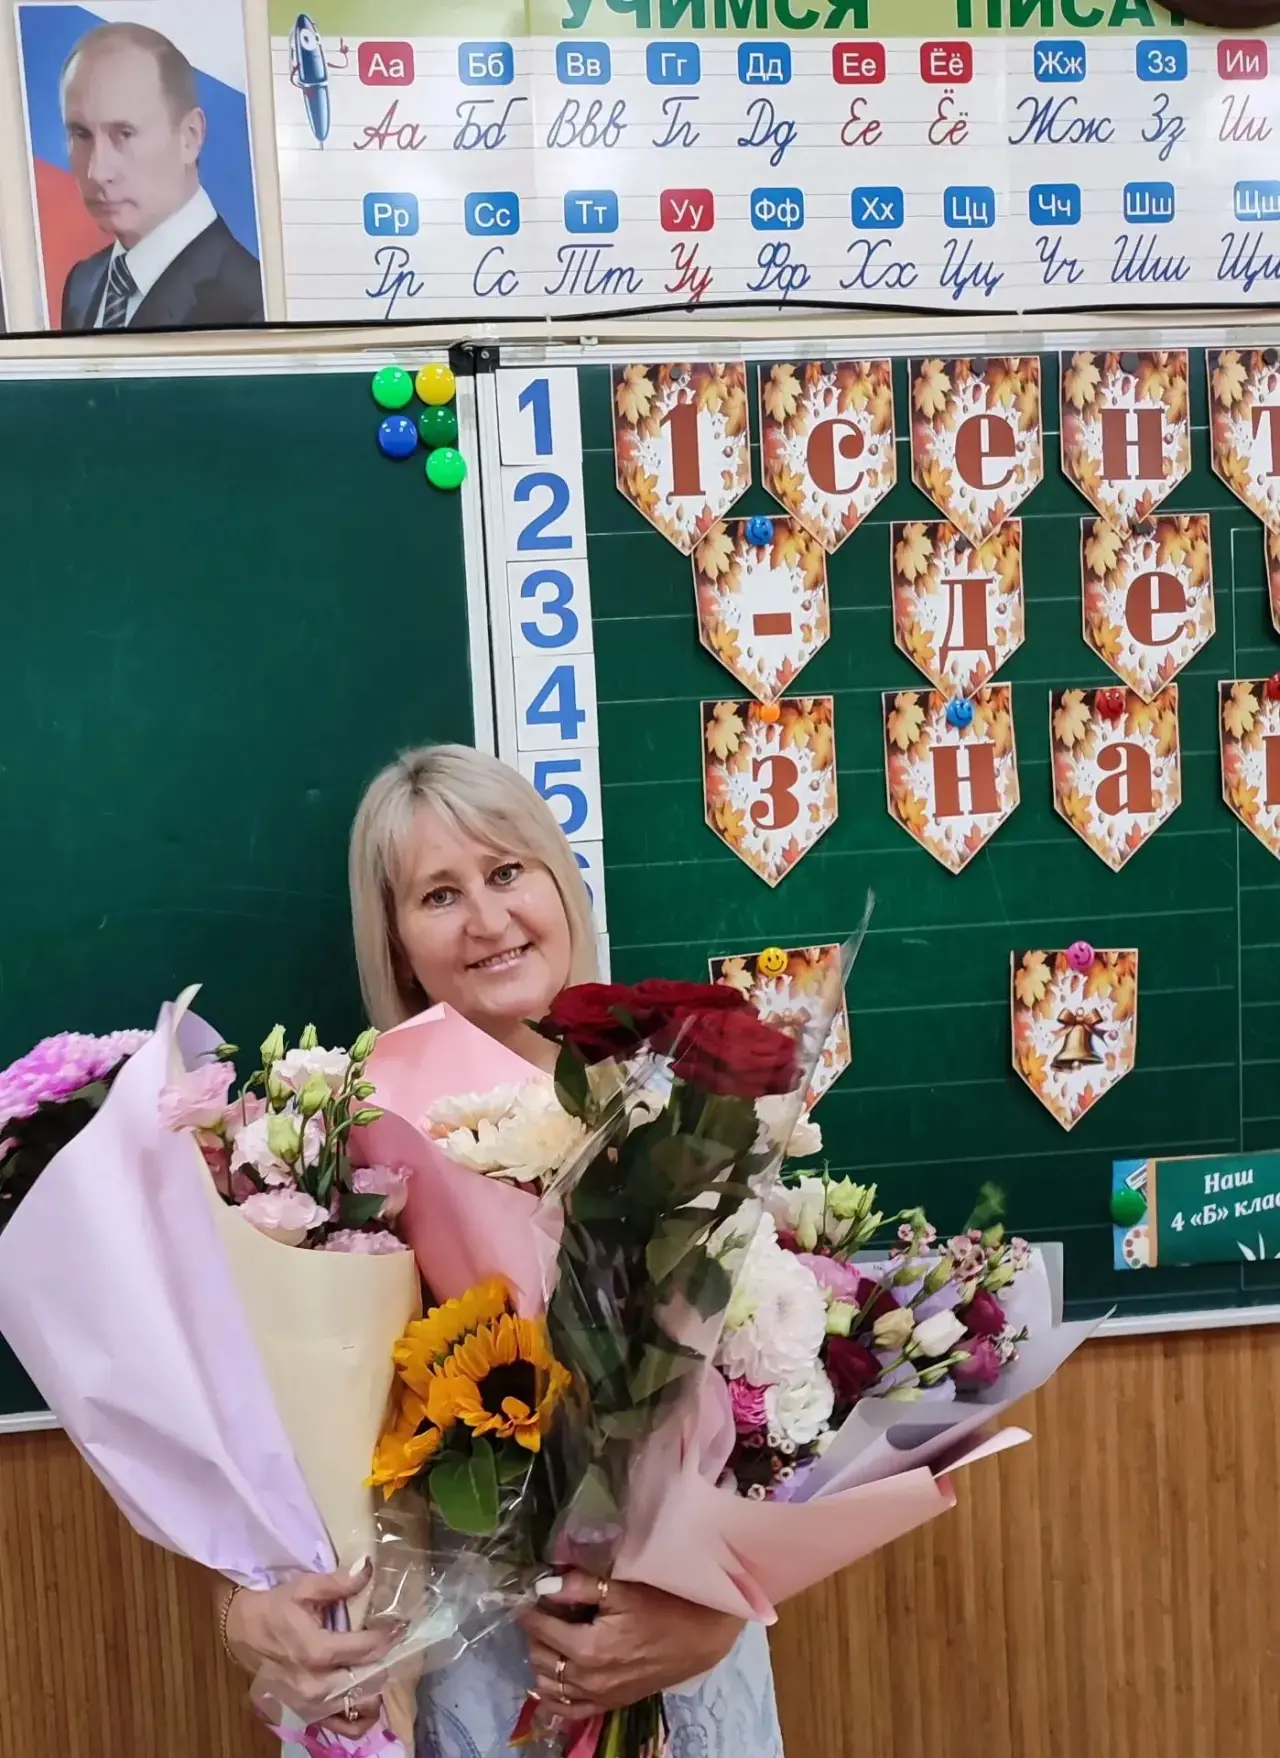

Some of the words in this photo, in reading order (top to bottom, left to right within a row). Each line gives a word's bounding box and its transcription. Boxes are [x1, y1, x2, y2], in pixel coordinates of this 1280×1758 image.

[561, 0, 869, 29] УЧИМСЯ
[367, 55, 405, 78] Аа
[468, 54, 504, 78] Бб
[567, 53, 601, 77] Вв
[660, 53, 688, 76] Гг
[746, 53, 784, 80] Дд
[843, 54, 877, 77] Ее
[930, 49, 964, 77] Ёё
[1037, 51, 1083, 75] Жж
[1148, 52, 1177, 75] Зз
[1226, 51, 1260, 73] Ии
[353, 99, 427, 151] Аа
[453, 96, 528, 151] Бб
[652, 96, 700, 148] Гг
[737, 98, 798, 168] Дд
[841, 97, 882, 147] Ее
[928, 89, 969, 146] Ёё
[1008, 96, 1115, 145] Жж
[1141, 93, 1186, 162] Зз
[1218, 94, 1273, 143] Ии
[373, 203, 409, 232] Рр
[474, 203, 511, 228] Сс
[575, 200, 607, 224] Тт
[670, 199, 703, 230] Уу
[755, 198, 800, 228] Фф
[861, 197, 895, 221] Хх
[952, 196, 987, 225] Цц
[1038, 193, 1071, 217] Чч
[1126, 191, 1172, 215] Шш
[366, 246, 424, 320] Рр
[473, 246, 519, 296] Сс
[544, 243, 643, 295] Тт
[664, 242, 713, 313] Уу
[746, 241, 811, 311] Фф
[839, 239, 918, 289] Хх
[939, 239, 1004, 300] Цц
[1035, 235, 1084, 284] Чч
[1110, 234, 1191, 283] Шш
[518, 379, 553, 455] 1
[514, 472, 570, 551] 2
[520, 569, 579, 649] 3
[525, 665, 586, 740] 4
[534, 759, 588, 835] 5
[1171, 1212, 1185, 1232] 4
[1190, 1203, 1229, 1227] «Б»
[1204, 1168, 1254, 1194] Наш
